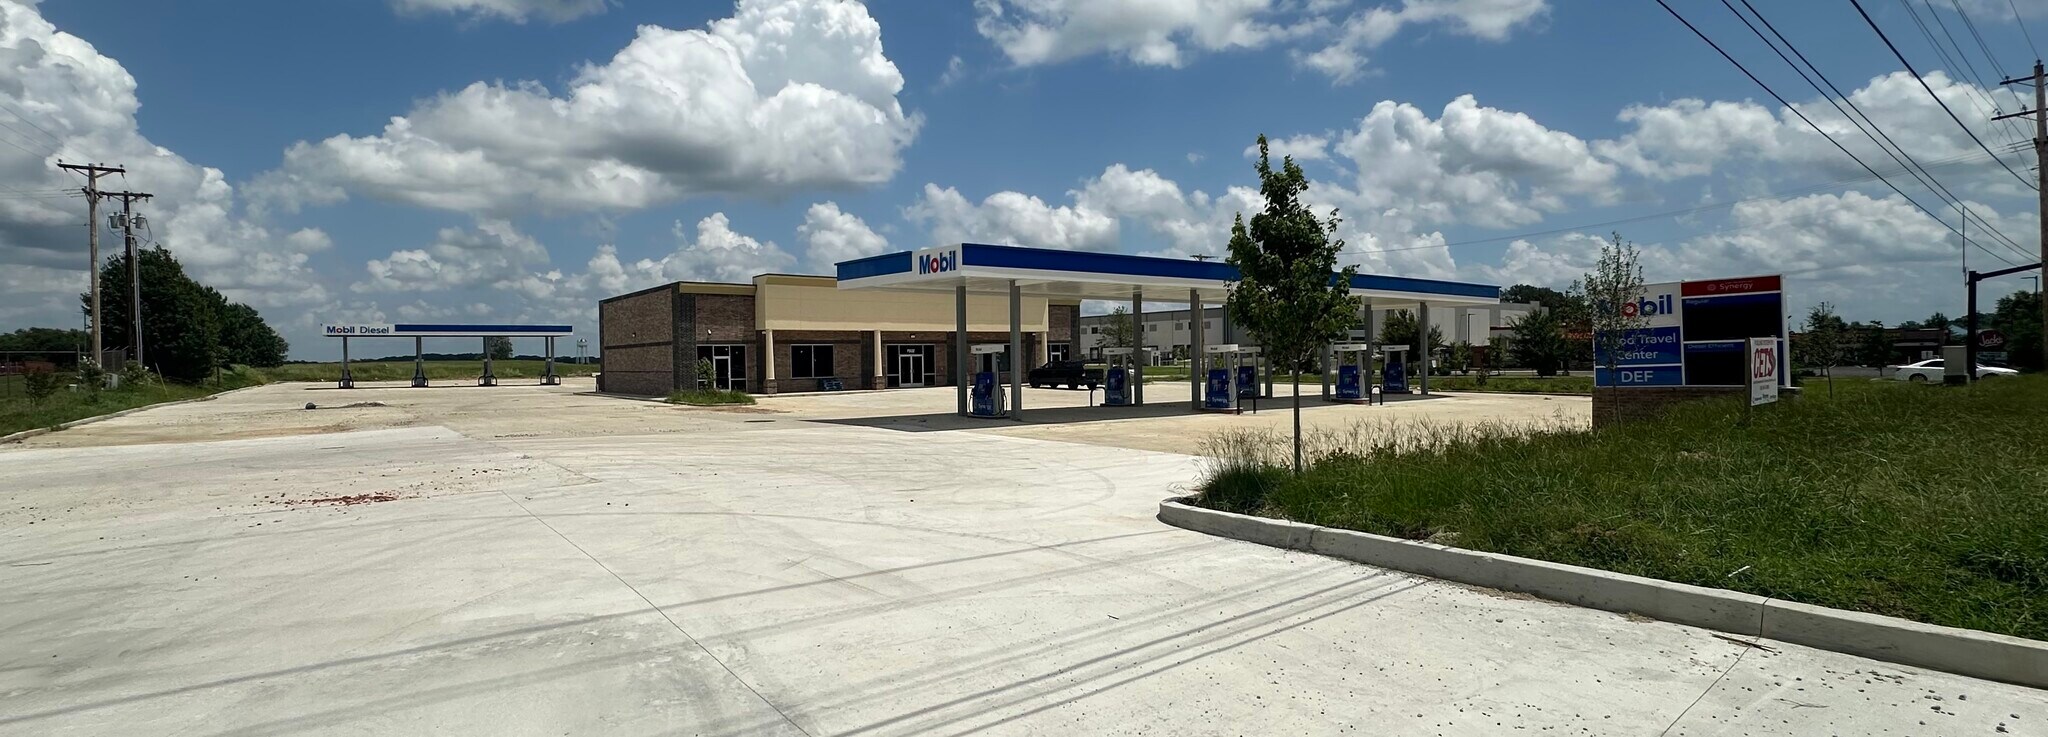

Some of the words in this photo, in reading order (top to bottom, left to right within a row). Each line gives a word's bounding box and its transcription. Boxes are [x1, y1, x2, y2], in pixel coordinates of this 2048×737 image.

[919, 250, 956, 275] Mobil
[1719, 282, 1753, 291] Synergy
[326, 325, 355, 334] Mobil
[360, 326, 389, 334] Diesel
[1638, 332, 1676, 344] Travel
[1617, 350, 1659, 360] Center
[1621, 370, 1654, 383] DEF
